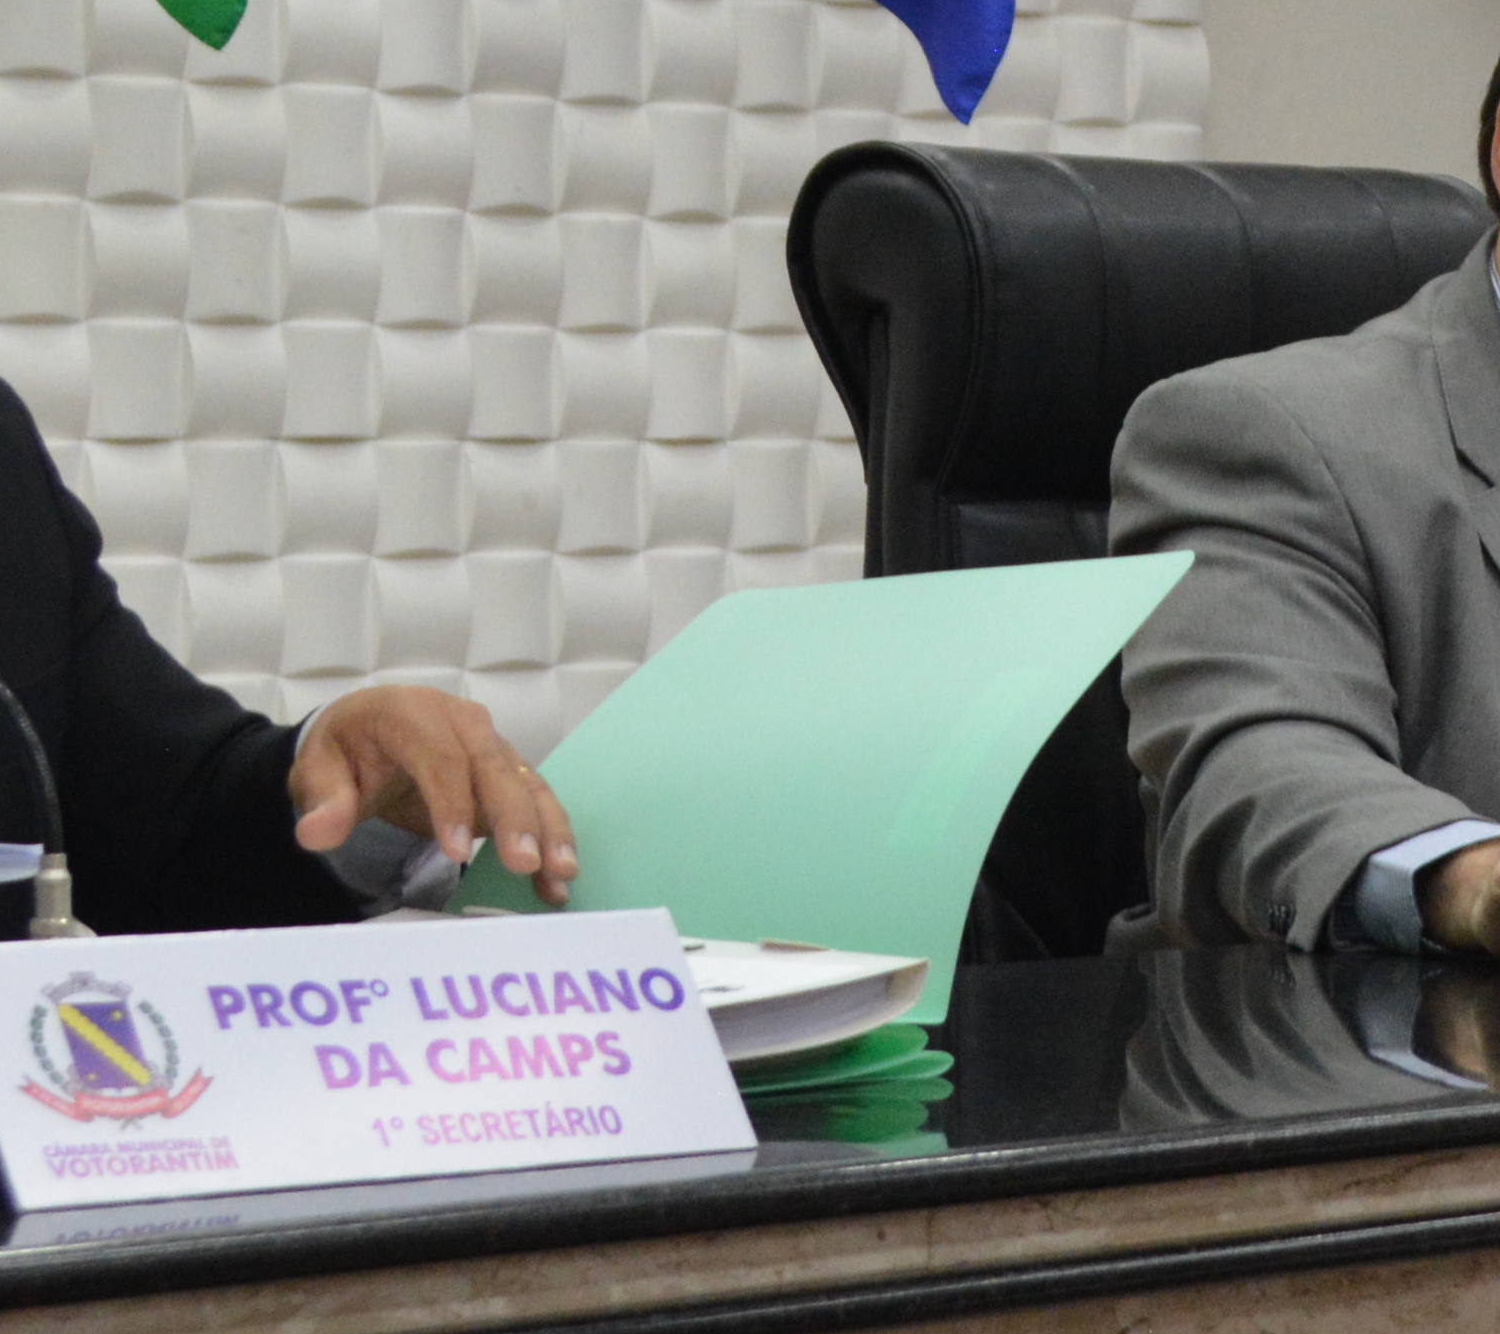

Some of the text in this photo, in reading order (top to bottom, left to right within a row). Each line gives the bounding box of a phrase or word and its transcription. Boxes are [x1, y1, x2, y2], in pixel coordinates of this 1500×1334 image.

[409, 966, 686, 1022] LUCIANO
[313, 1030, 633, 1091] DA CAMPS
[116, 1137, 206, 1154] MUNICIPAL
[415, 1101, 624, 1147] SECRETÁRIO
[47, 1150, 240, 1179] VOTORANTIM
